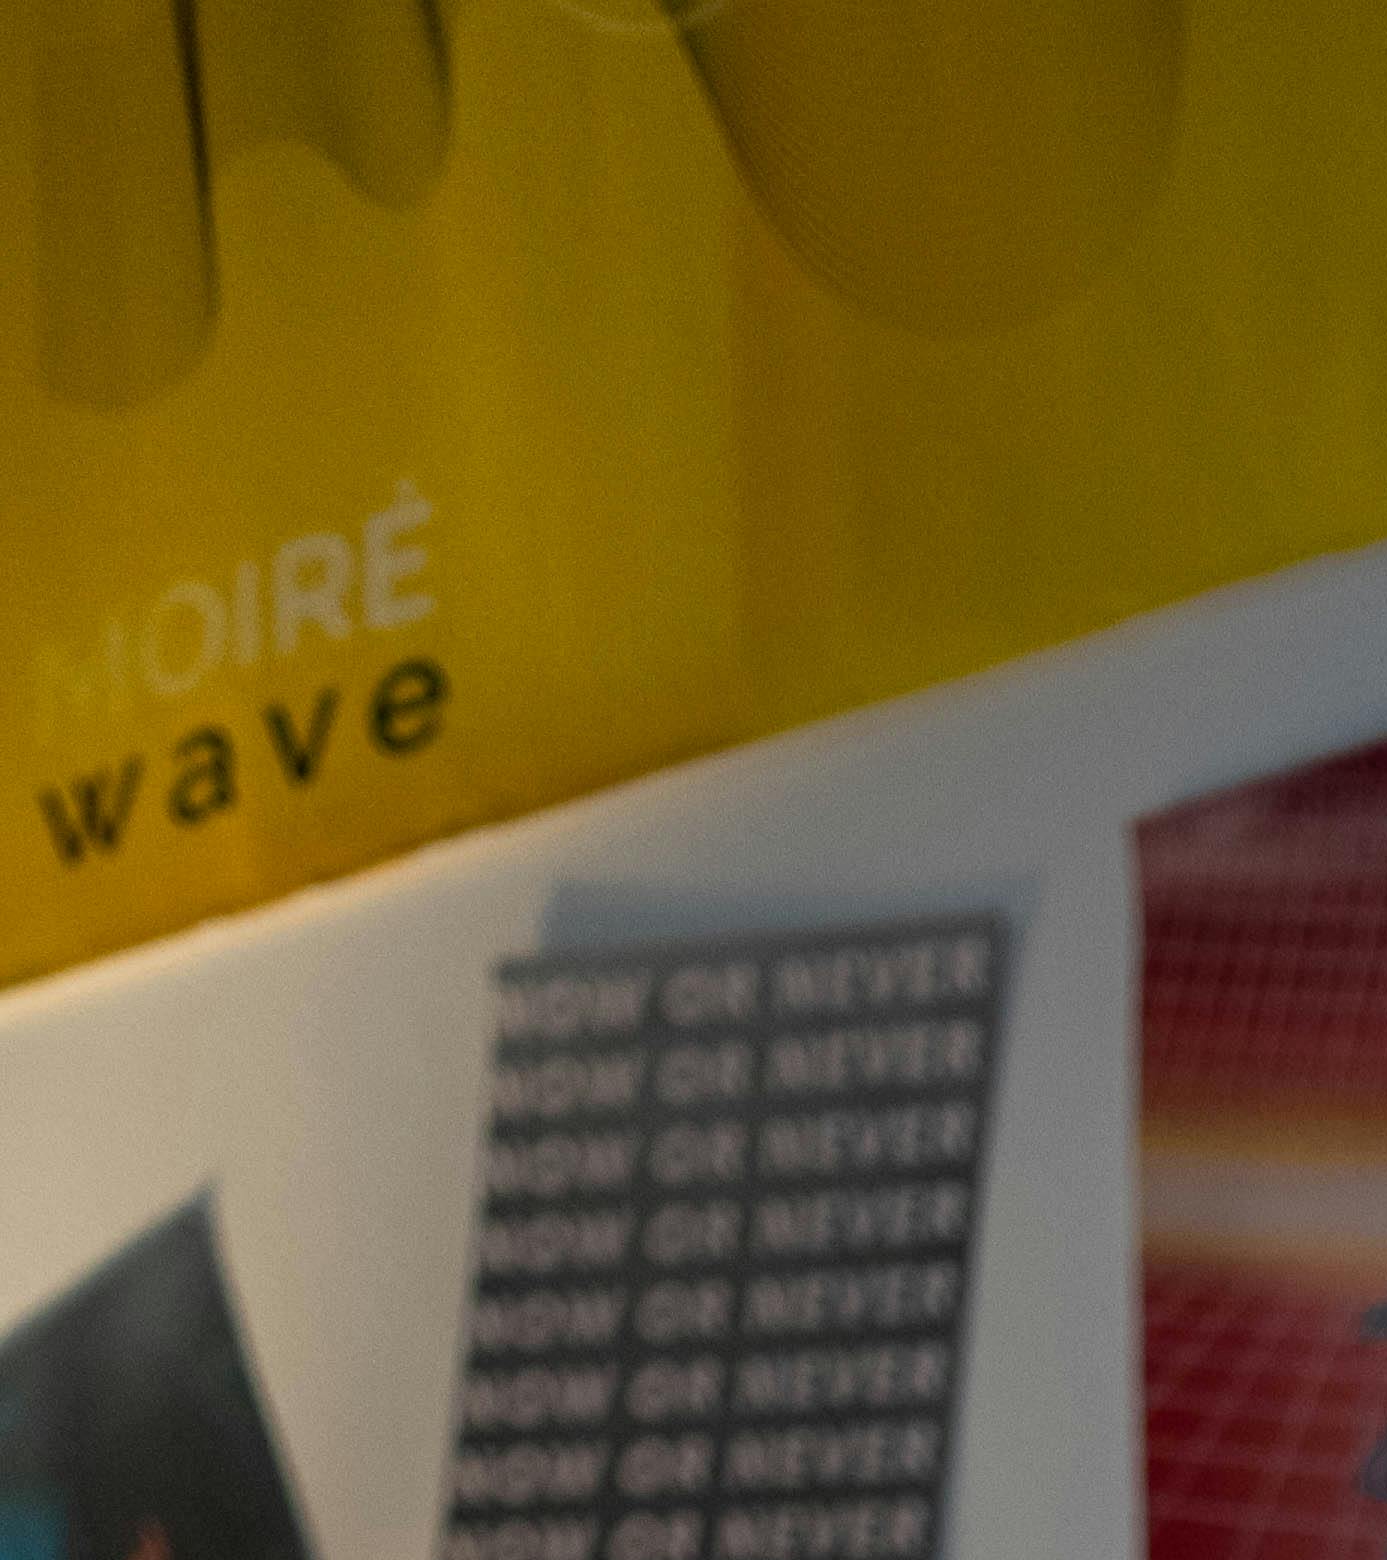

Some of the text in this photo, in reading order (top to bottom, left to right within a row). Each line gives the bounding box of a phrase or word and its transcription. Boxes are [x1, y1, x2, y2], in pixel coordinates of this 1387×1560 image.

[34, 653, 453, 868] wave
[495, 937, 987, 1037] NOW OR NEVER
[492, 1020, 980, 1115] NOW OR NEVER
[485, 1100, 973, 1195] NOW OR NEVER
[480, 1180, 965, 1272] NOW OR NEVER
[472, 1260, 958, 1350] NOW OR NEVER
[465, 1342, 952, 1430] NOW OR NEVER
[455, 1420, 941, 1505] NOW OR NEVER
